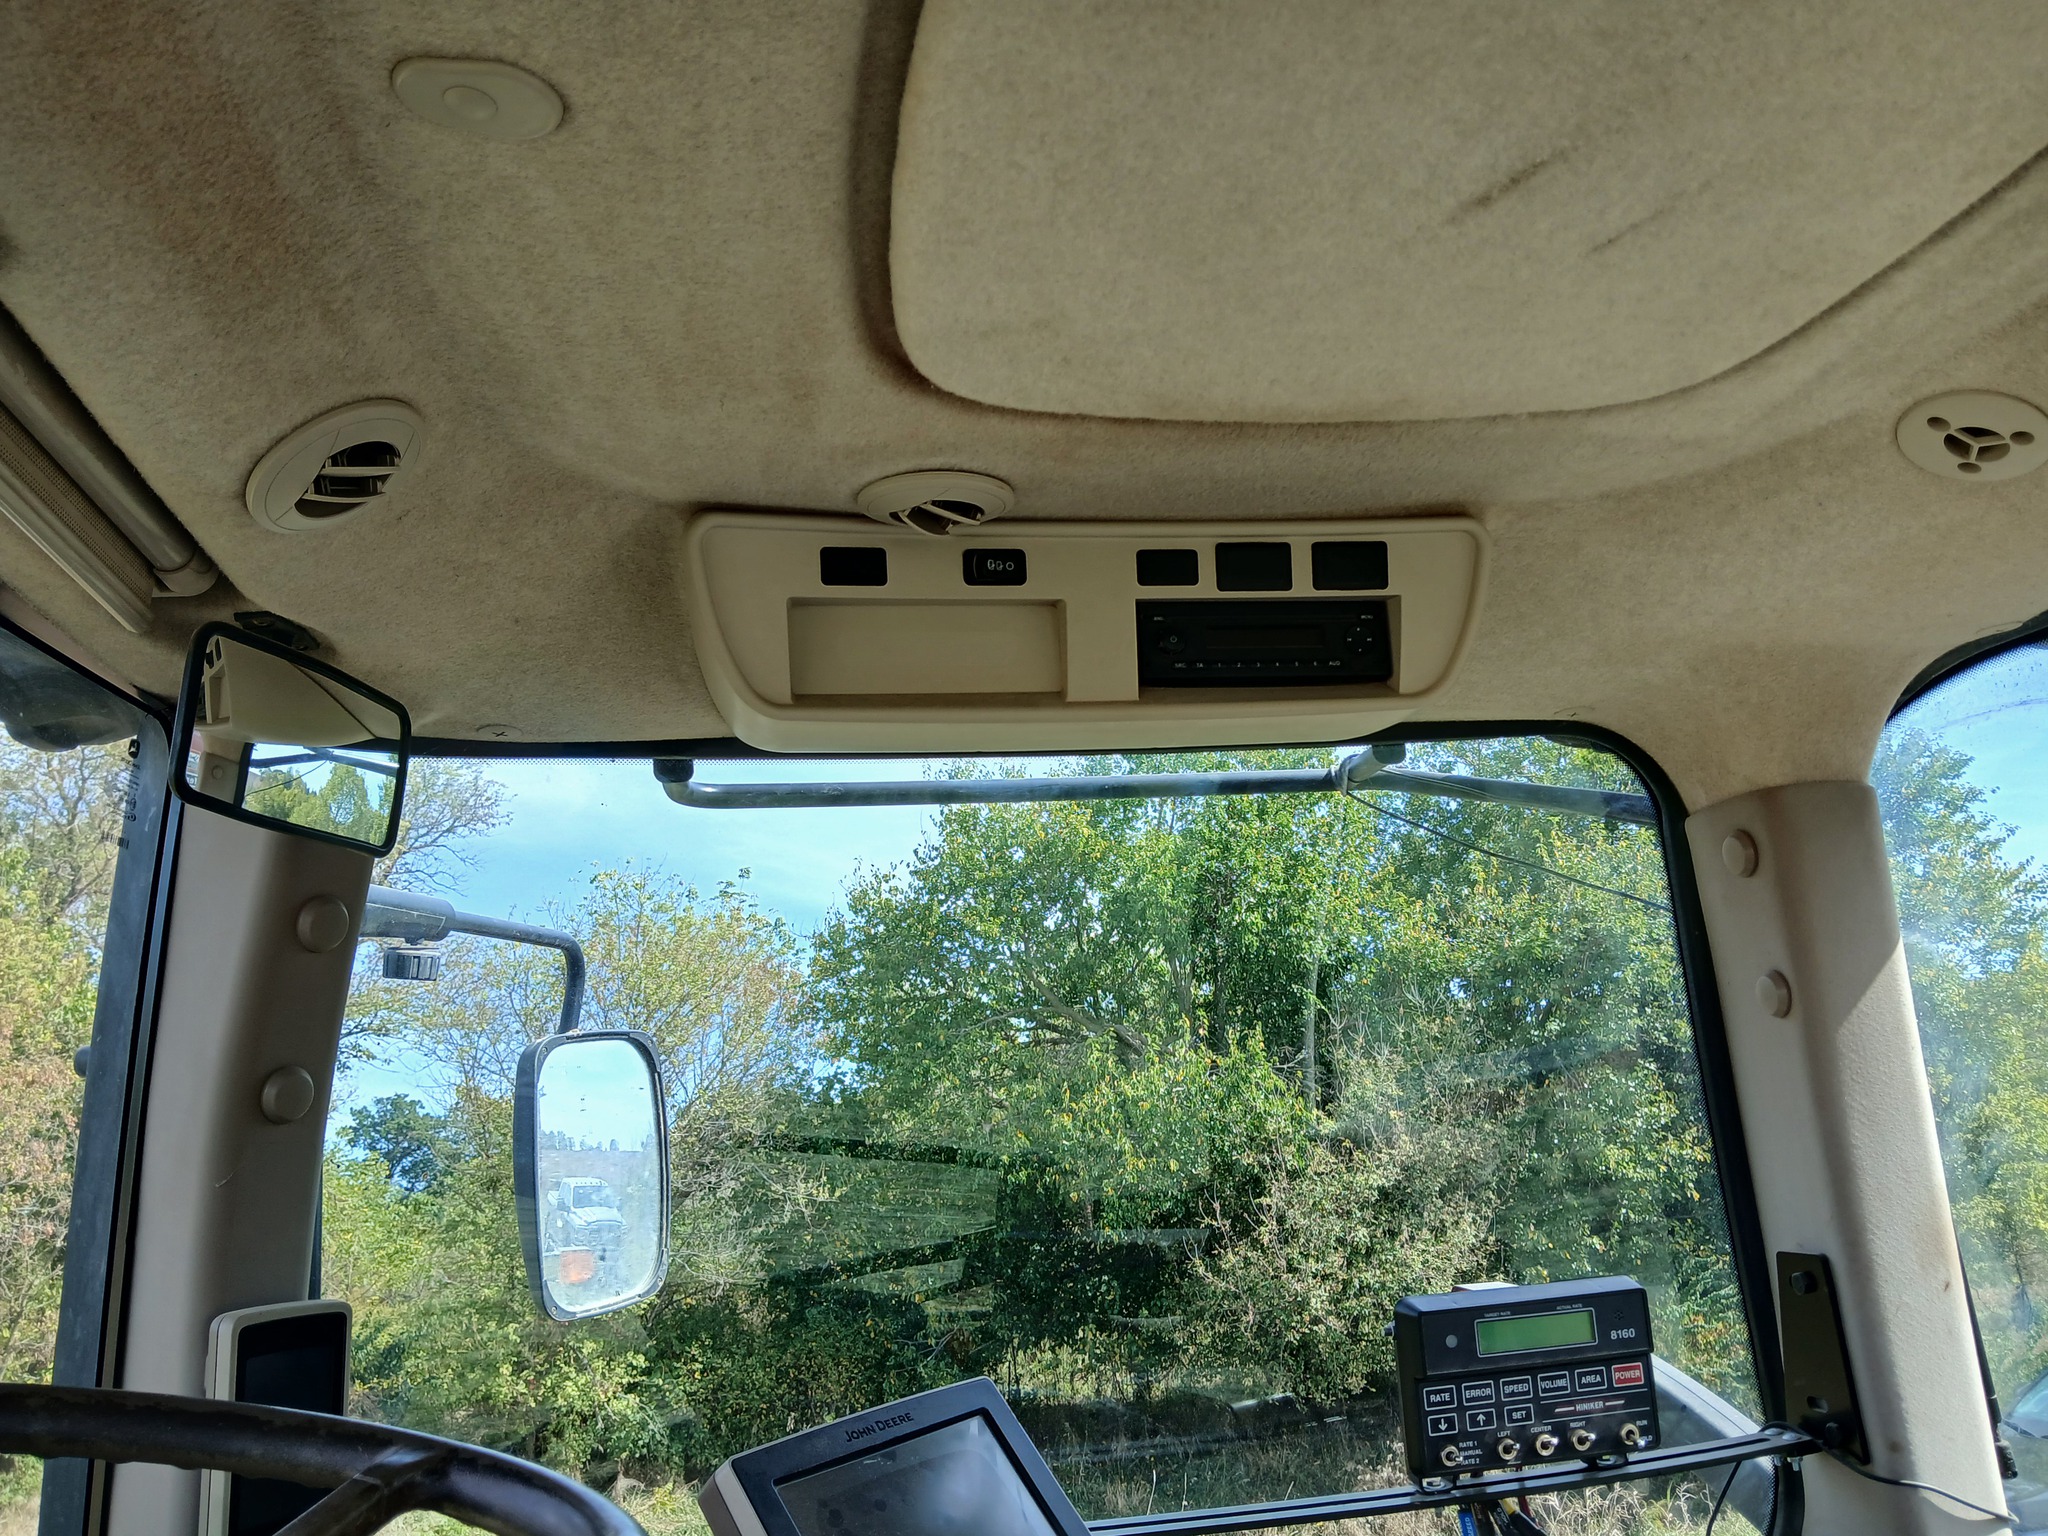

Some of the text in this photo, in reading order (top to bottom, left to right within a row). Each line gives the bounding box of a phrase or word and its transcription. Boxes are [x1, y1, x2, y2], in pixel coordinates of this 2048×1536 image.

[1610, 1328, 1636, 1340] 8160
[1581, 1374, 1602, 1384] AREA
[1615, 1369, 1641, 1380] POWER
[1504, 1383, 1529, 1394] SPEED
[1540, 1378, 1568, 1389] VOLUME
[1430, 1392, 1450, 1403] RATE
[1466, 1387, 1492, 1398] ERROR
[1575, 1401, 1604, 1412] HINIKER
[1512, 1411, 1527, 1419] SET
[845, 1412, 914, 1442] JOHN DEERE
